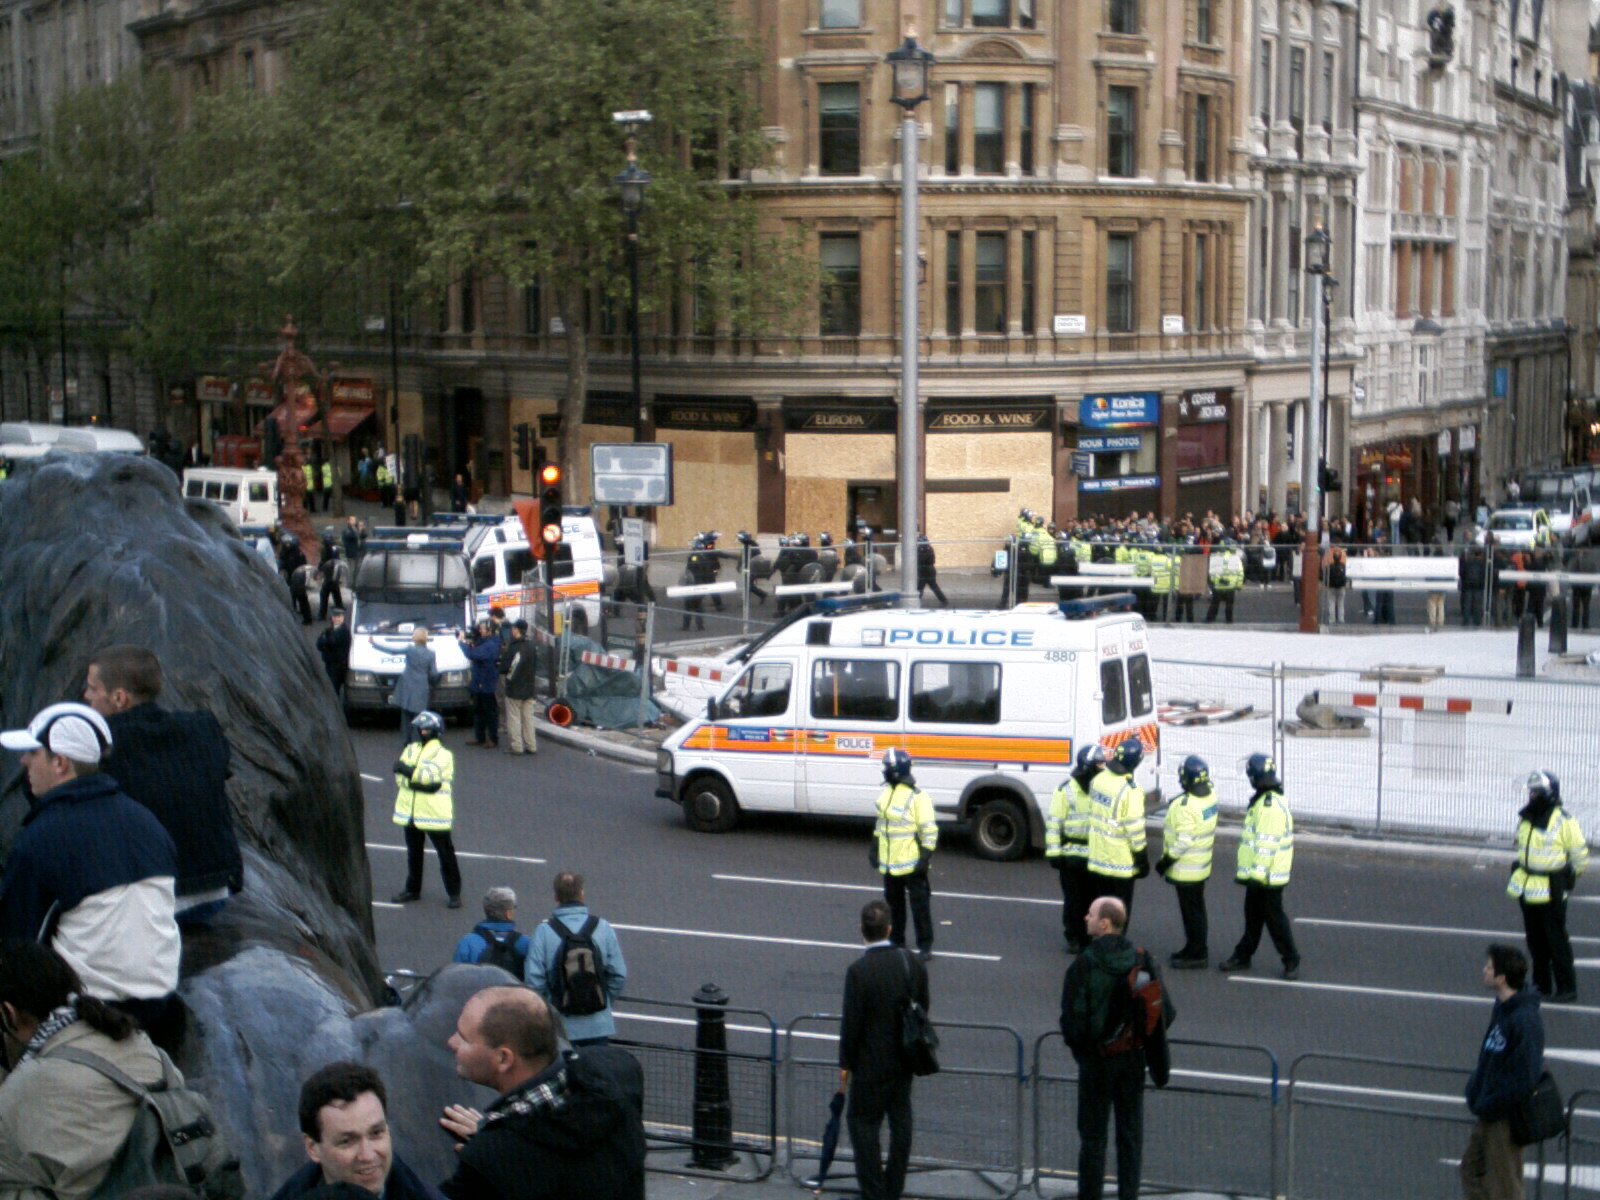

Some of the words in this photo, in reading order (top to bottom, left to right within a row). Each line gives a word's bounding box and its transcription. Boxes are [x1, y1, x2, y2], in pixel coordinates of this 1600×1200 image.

[1111, 397, 1145, 409] Konica
[815, 414, 865, 425] EUROPA
[943, 414, 980, 425] FOOD
[983, 414, 995, 425] &
[997, 413, 1033, 425] WINE
[1079, 439, 1103, 449] HOUR
[1106, 437, 1140, 447] PHOTOS
[889, 628, 1035, 646] POLICE
[1044, 650, 1077, 662] 4880
[837, 737, 871, 749] POLICE
